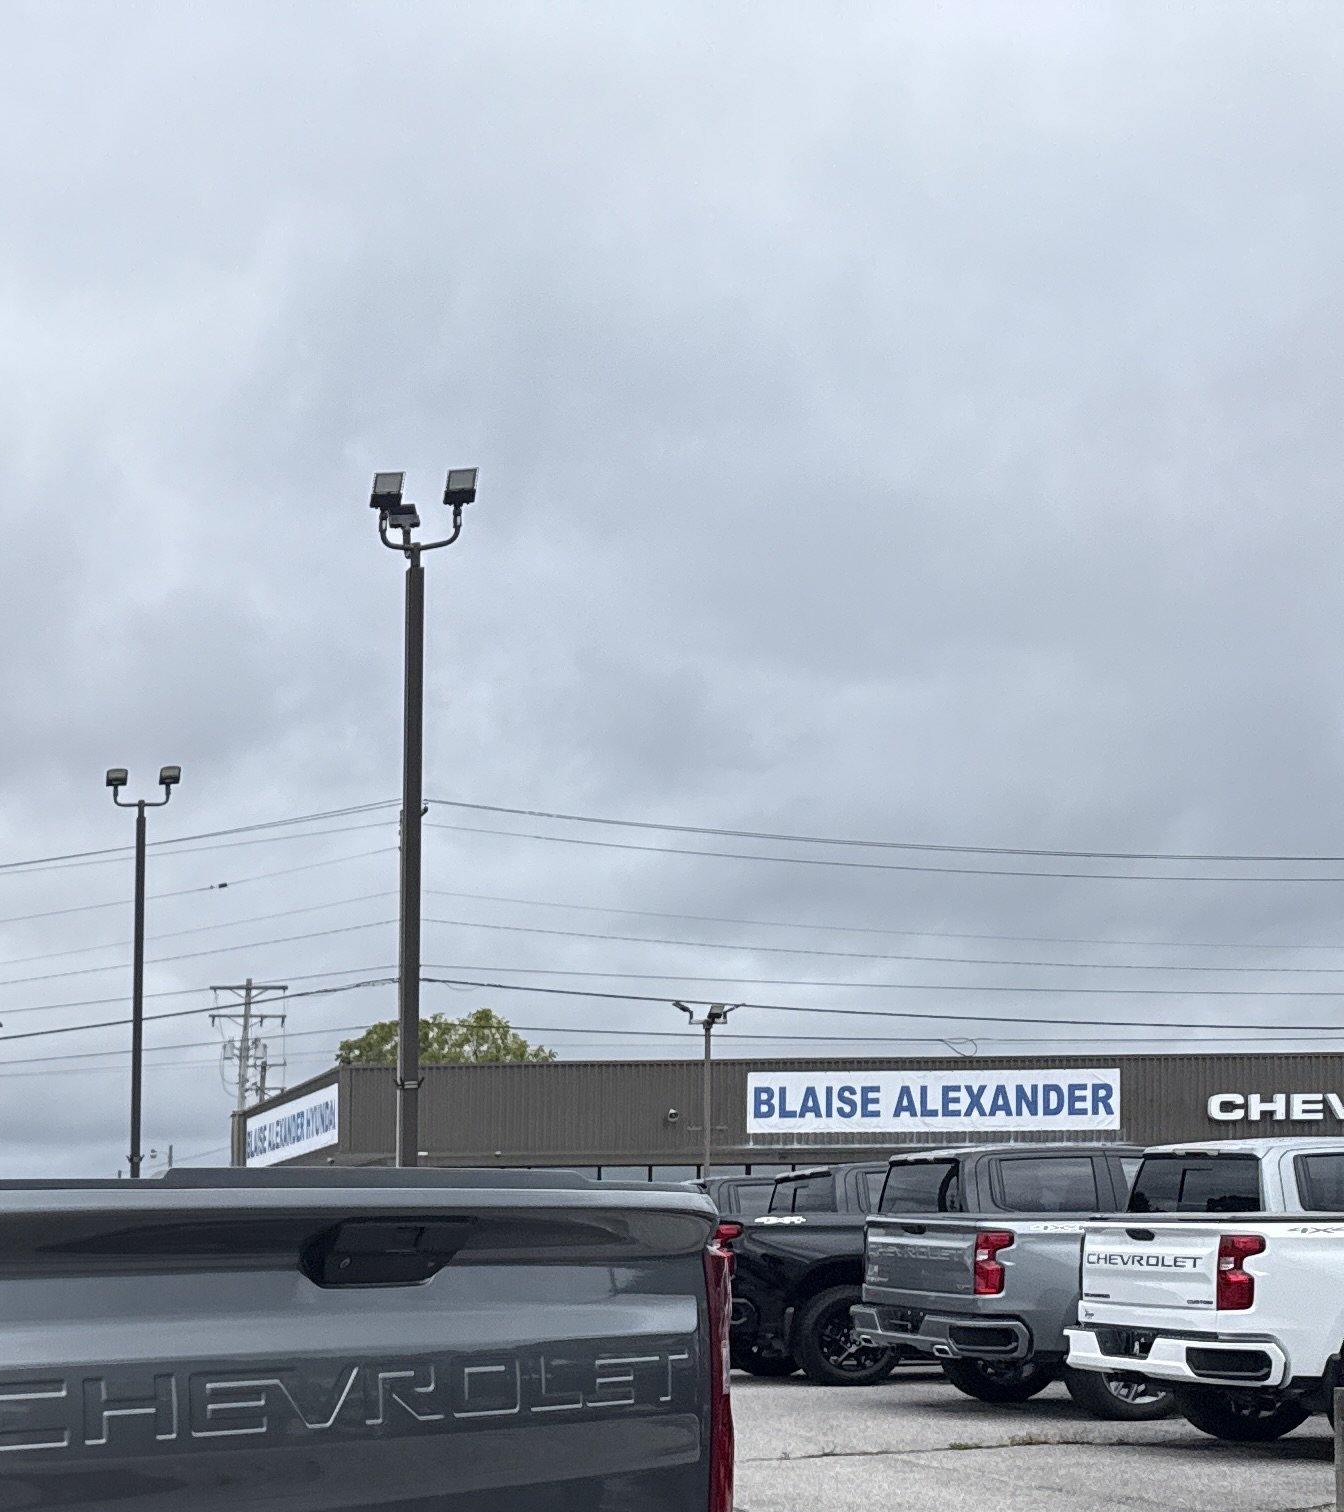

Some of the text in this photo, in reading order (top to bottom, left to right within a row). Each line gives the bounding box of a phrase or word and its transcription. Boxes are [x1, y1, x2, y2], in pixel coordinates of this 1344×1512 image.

[753, 1083, 1114, 1119] BLAISE ALEXANDER
[247, 1099, 336, 1158] BLAISE ALEXANDER HYUNDAI
[1086, 1252, 1203, 1269] CHEVROLET
